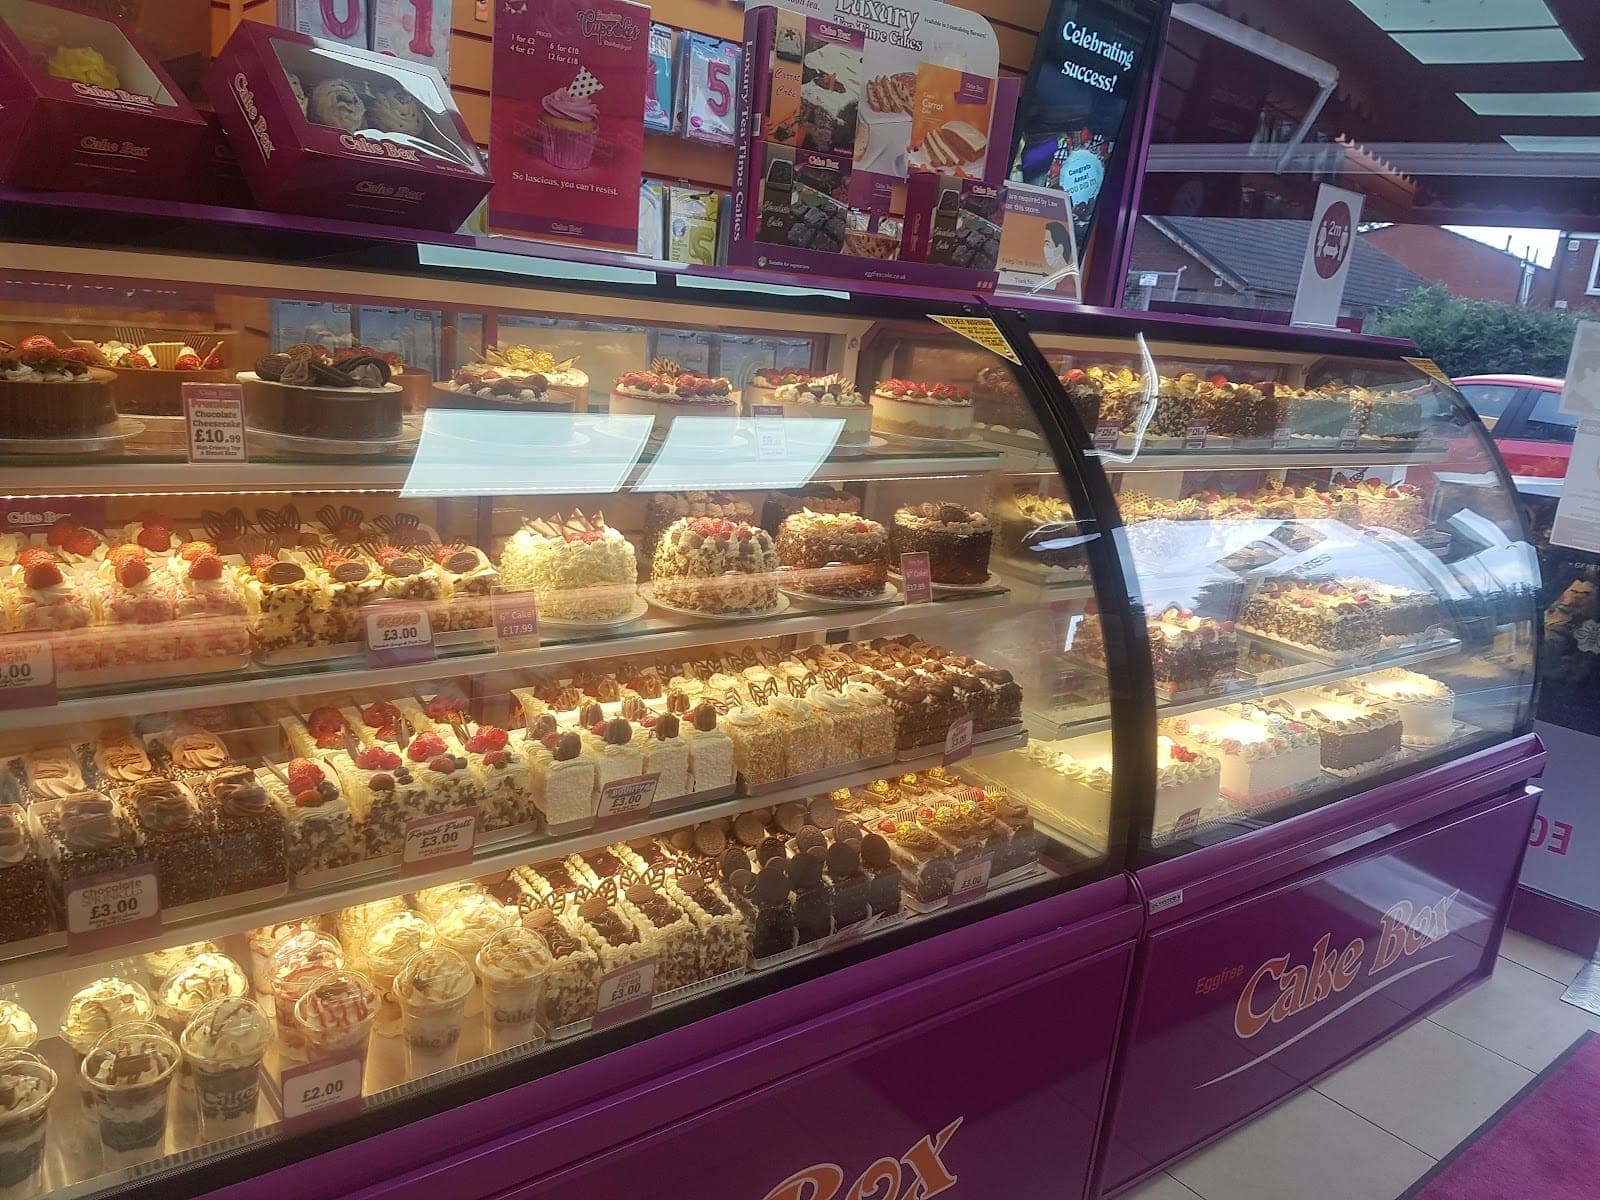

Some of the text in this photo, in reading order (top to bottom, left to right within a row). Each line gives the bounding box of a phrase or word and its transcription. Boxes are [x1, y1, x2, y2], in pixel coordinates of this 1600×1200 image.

[577, 9, 641, 46] Cupcakes
[835, 0, 919, 39] Luxury
[516, 35, 526, 43] for
[528, 37, 536, 45] £2
[856, 20, 888, 41] Time
[889, 30, 923, 51] Cakes
[516, 45, 525, 53] for
[527, 47, 535, 55] £7
[557, 44, 567, 52] for
[568, 46, 579, 55] £10
[1062, 21, 1135, 72] Celebrating
[556, 54, 566, 62] for
[1061, 60, 1118, 93] success!
[71, 82, 155, 106] Cake Box
[707, 59, 731, 117] 5
[922, 98, 944, 111] Carrot
[235, 72, 277, 160] Cake Box
[80, 136, 151, 157] Cake Box
[339, 134, 421, 162] Cake Box
[733, 40, 754, 242] Luxury Tea Time Cakes
[356, 181, 425, 200] Cake Box
[512, 171, 619, 197] So luscious, you can't resist.
[1328, 221, 1342, 237] 2m
[192, 419, 241, 428] Cheesecake
[194, 410, 238, 419] Chocolate
[194, 429, 241, 443] £10.99
[7, 511, 43, 523] Cake
[511, 608, 535, 620] Cake!
[384, 626, 418, 642] £3.00
[503, 624, 533, 636] £17.99
[611, 794, 642, 808] £3.00
[408, 818, 473, 842] Forest Fruit
[420, 831, 458, 849] £3.00
[82, 880, 142, 898] Chocolate
[90, 897, 138, 920] £3.00
[1195, 888, 1460, 1039] Eggfree Cake Box
[612, 982, 641, 1001] £3.00
[301, 1079, 344, 1104] £2.00
